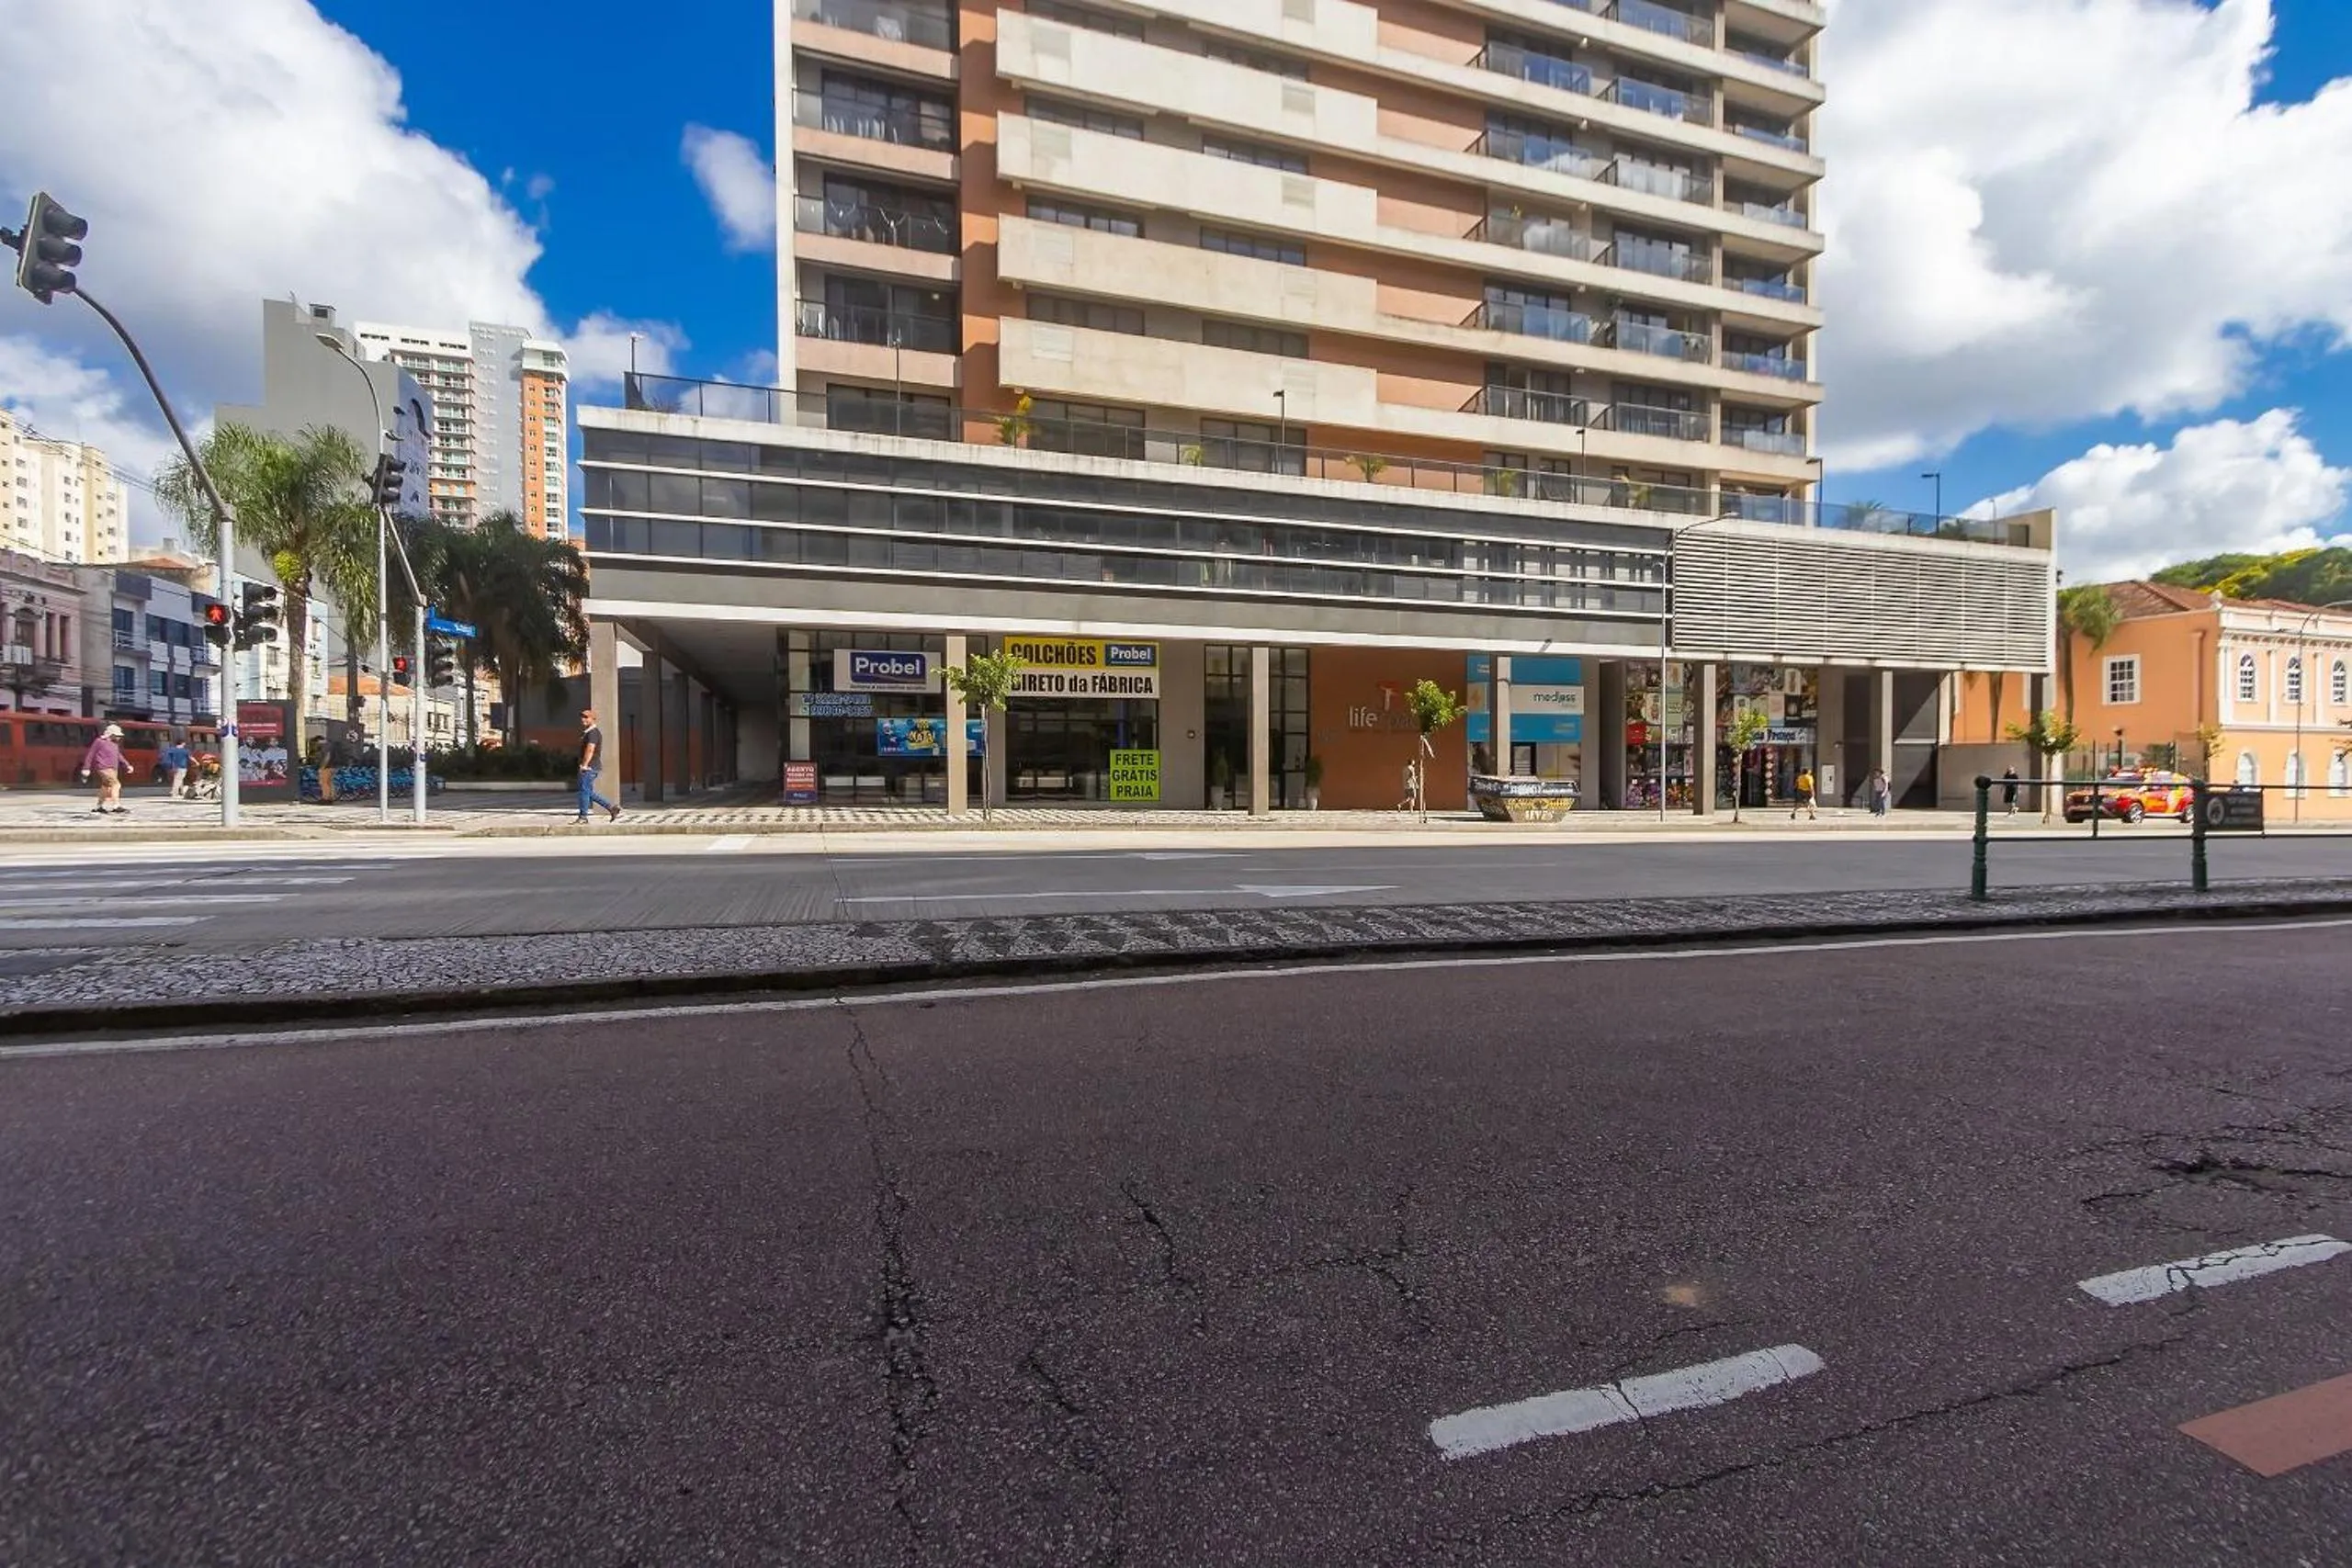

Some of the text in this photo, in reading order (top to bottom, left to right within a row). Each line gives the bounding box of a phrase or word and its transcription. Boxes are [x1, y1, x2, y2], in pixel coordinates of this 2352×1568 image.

[1012, 642, 1096, 665] COLCHÕES
[1111, 647, 1151, 660] Probel
[855, 657, 920, 674] Probel
[1069, 674, 1088, 693] da
[1091, 672, 1153, 694] FÁBRICA
[1349, 705, 1378, 728] life
[1115, 753, 1154, 765] FRETE
[1113, 769, 1157, 781] GRÁTIS
[1116, 785, 1154, 797] PRAIA
